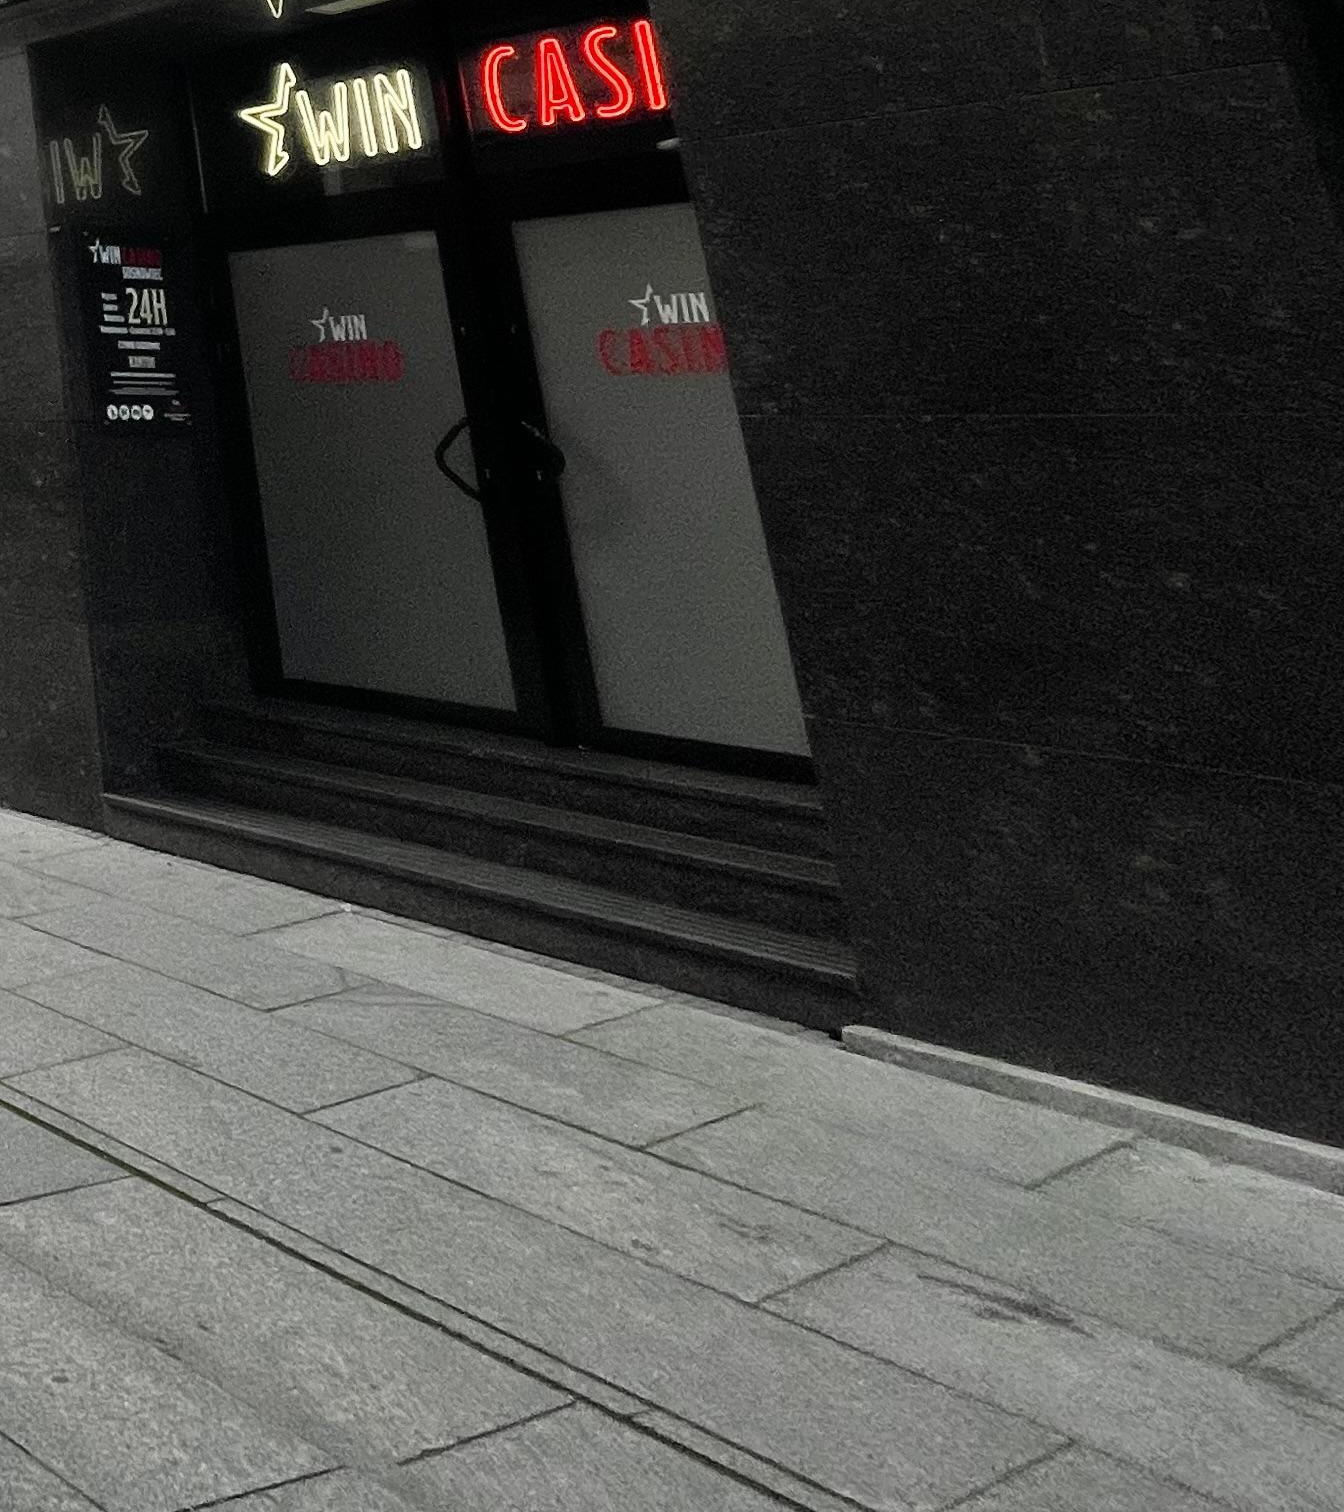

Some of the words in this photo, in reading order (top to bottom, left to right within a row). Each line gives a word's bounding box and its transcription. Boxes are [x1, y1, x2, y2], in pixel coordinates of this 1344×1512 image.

[295, 69, 422, 166] WIN
[482, 20, 667, 132] CASI
[125, 287, 168, 326] 24H
[653, 292, 710, 324] WIN
[329, 314, 368, 341] WIN
